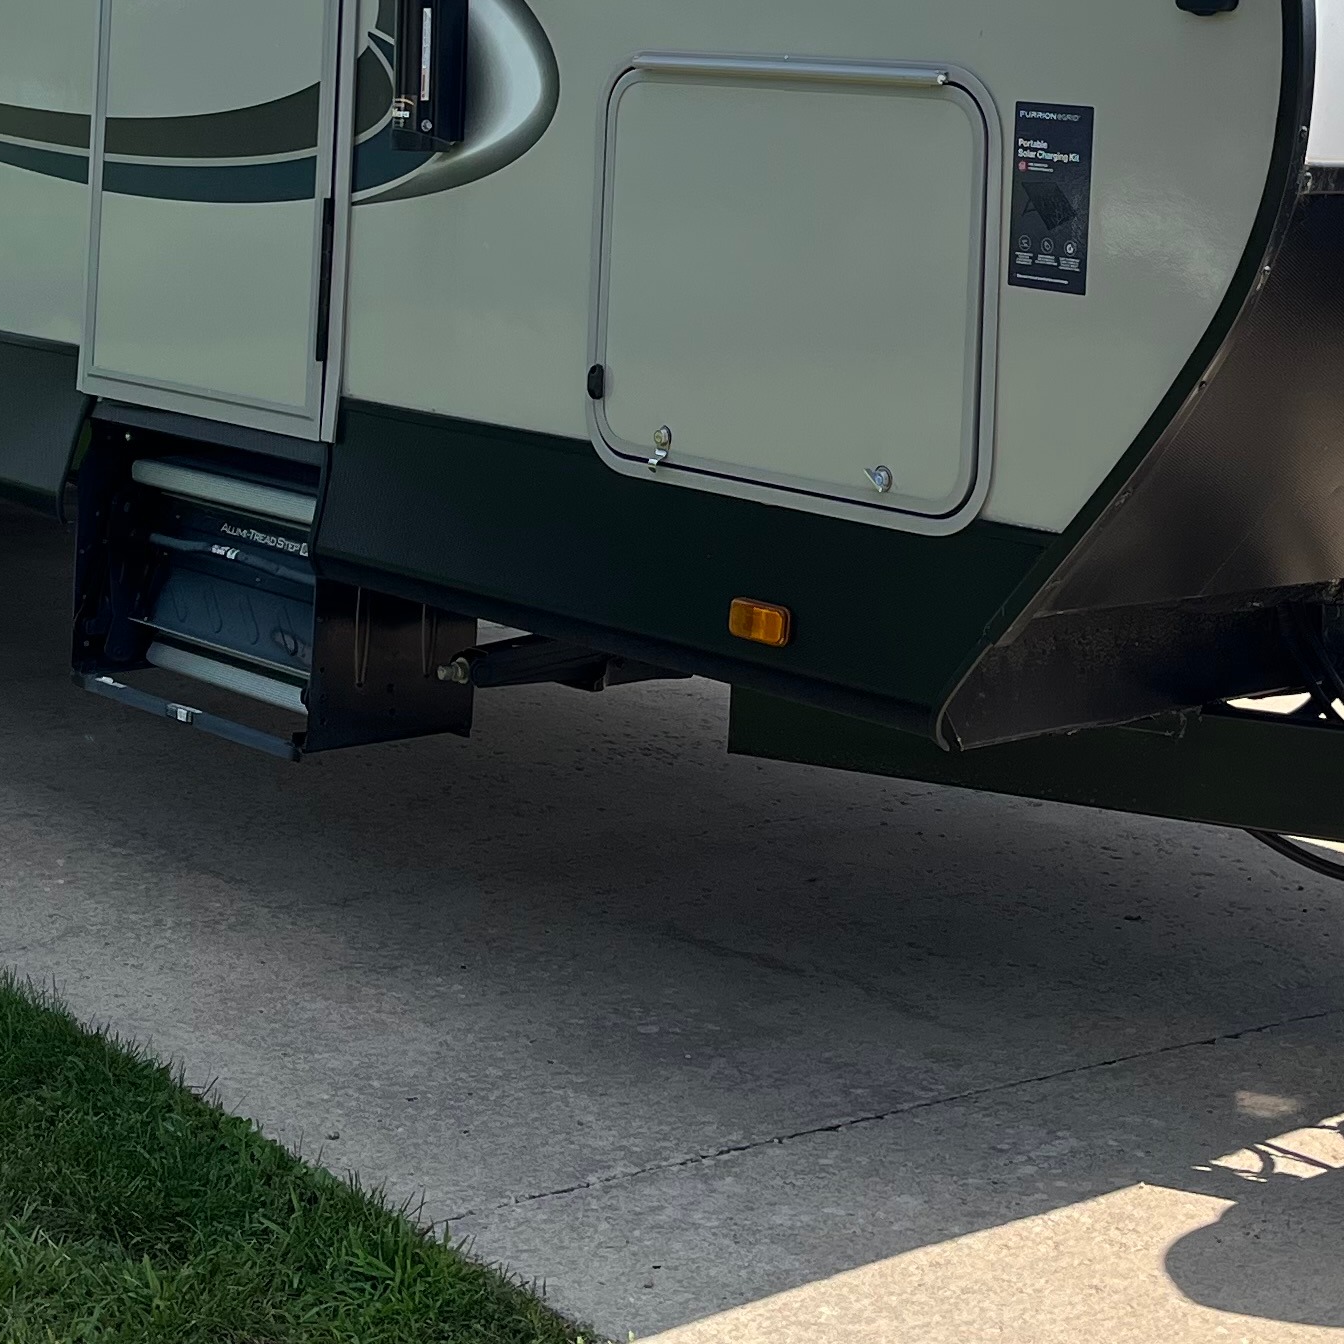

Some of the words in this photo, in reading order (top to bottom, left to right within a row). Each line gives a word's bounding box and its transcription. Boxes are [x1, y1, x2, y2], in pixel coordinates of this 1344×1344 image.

[1018, 137, 1048, 149] Portable
[1017, 148, 1037, 158] Solar
[1037, 149, 1069, 164] Charging
[1068, 153, 1080, 163] Kit
